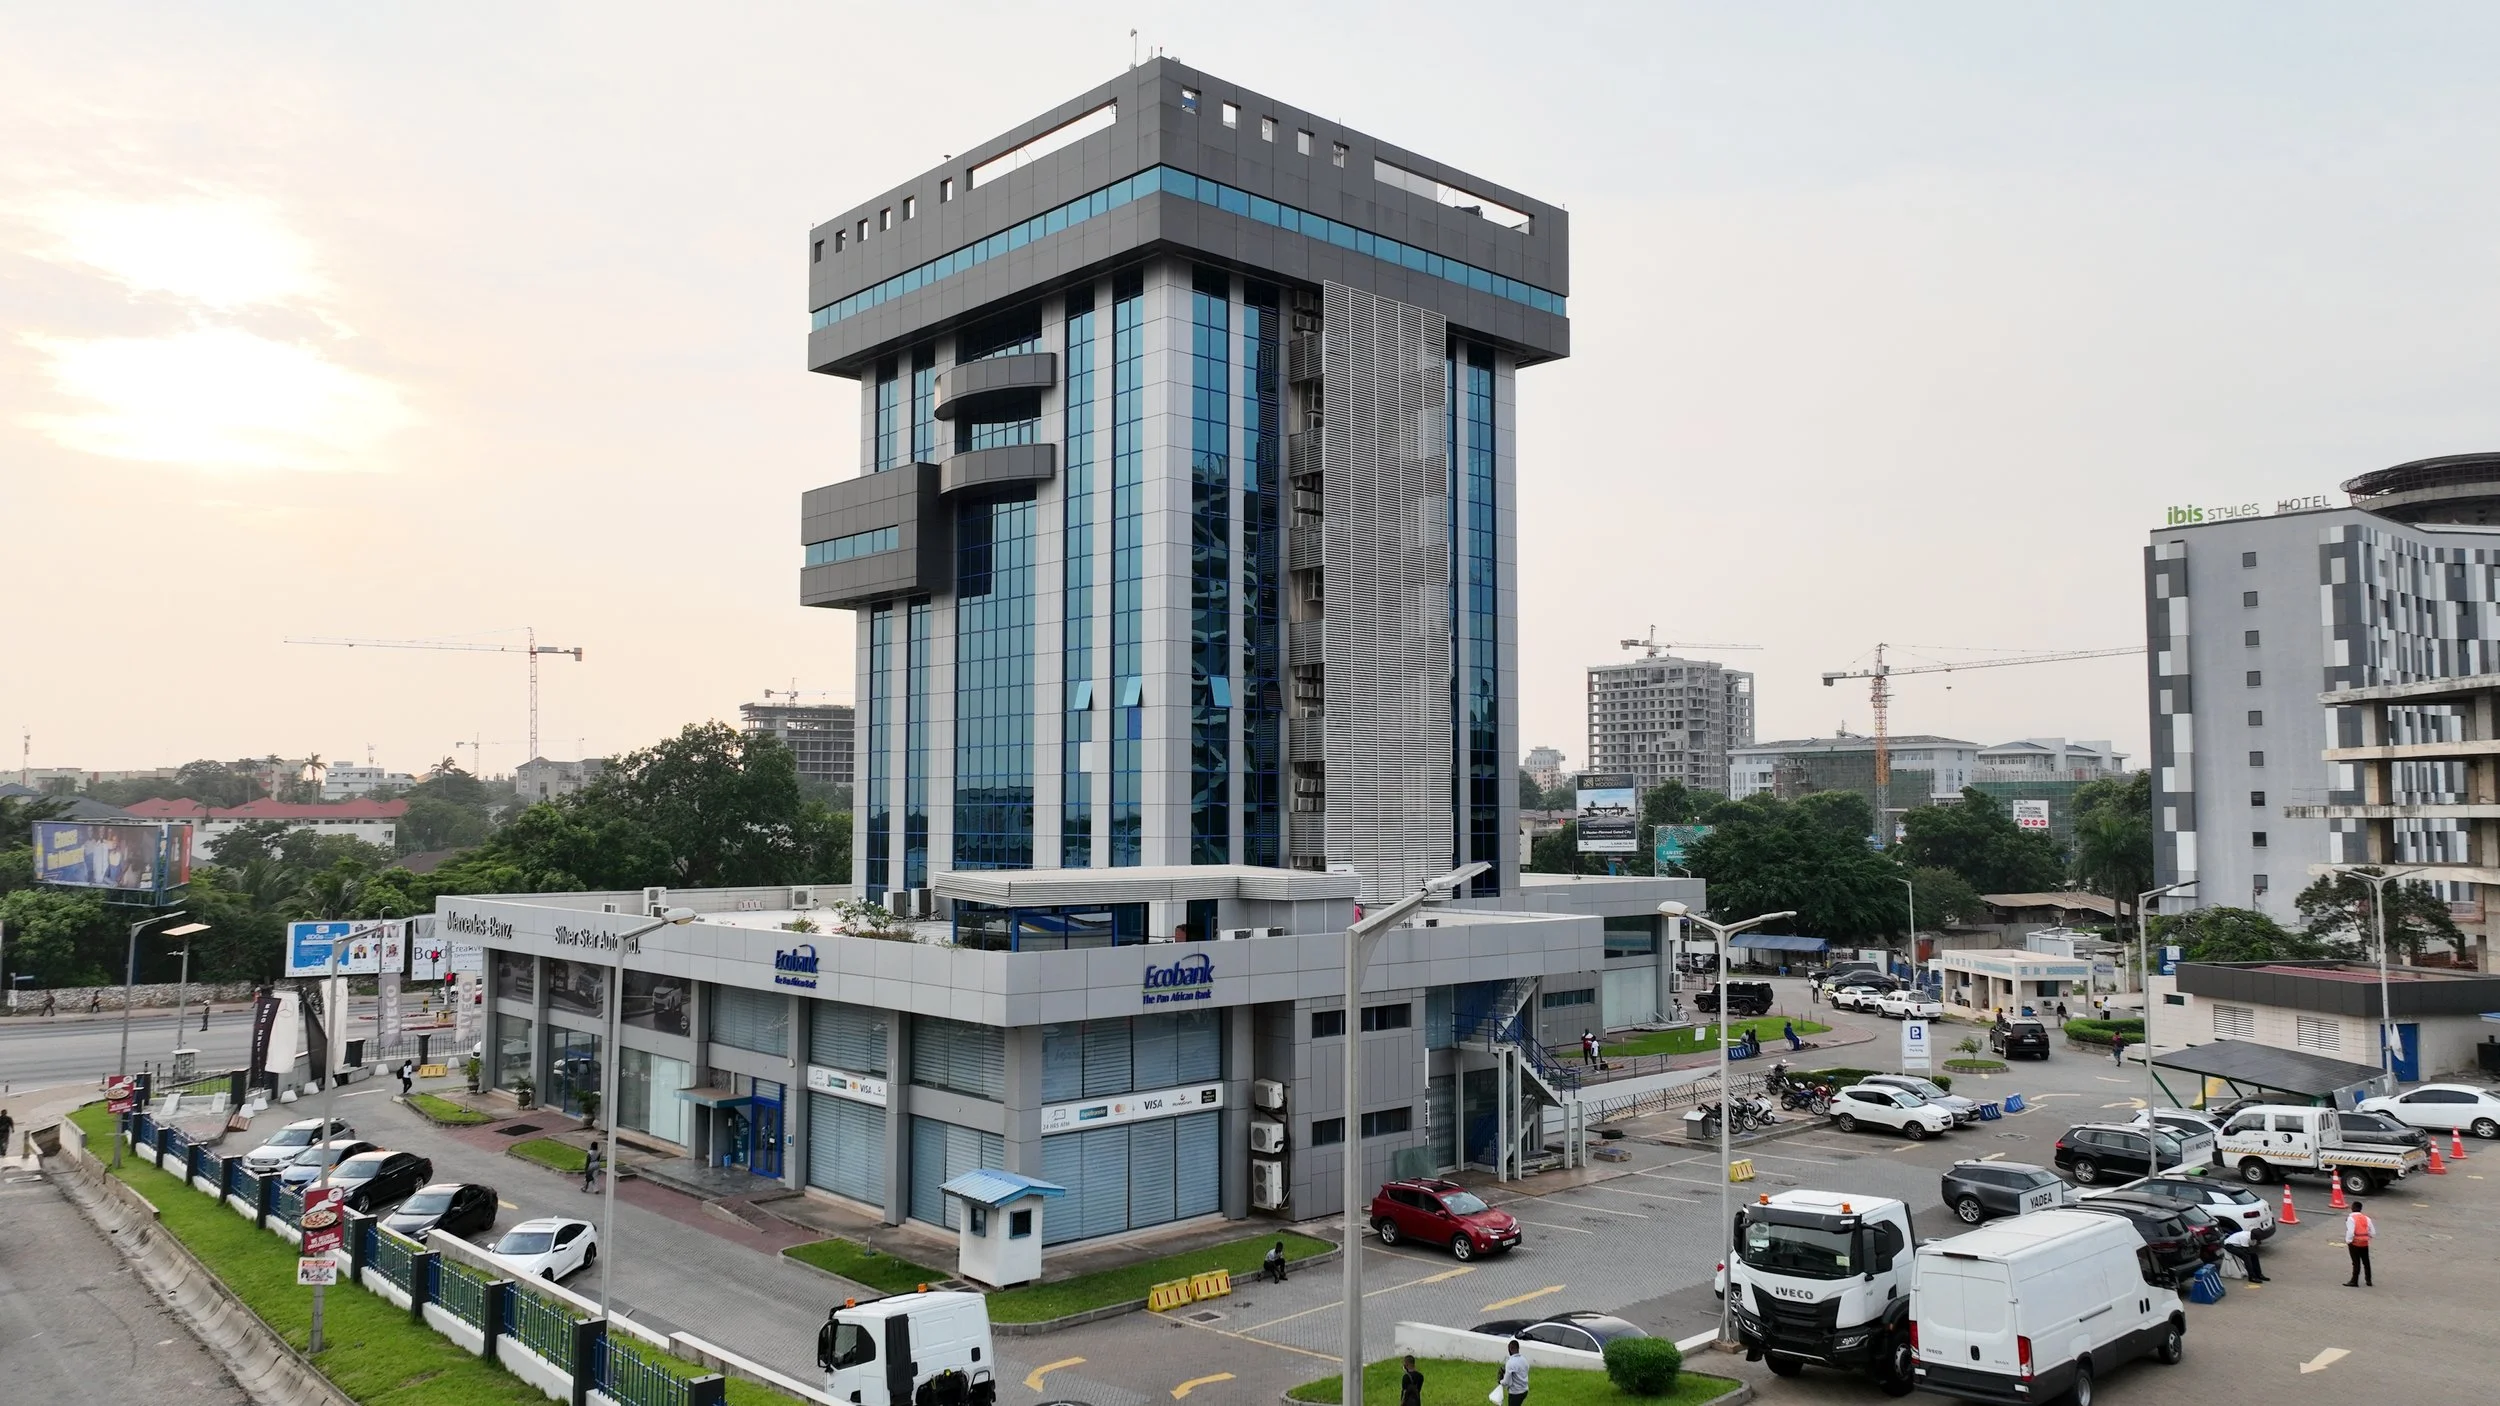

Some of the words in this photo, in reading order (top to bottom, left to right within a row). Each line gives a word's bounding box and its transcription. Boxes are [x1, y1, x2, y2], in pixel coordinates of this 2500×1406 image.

[2167, 504, 2204, 525] ibis
[2208, 503, 2260, 521] STYLES
[2277, 495, 2331, 512] HOTEL
[447, 911, 512, 939] Mercedes-Benz
[555, 926, 579, 945] Silver
[580, 929, 599, 947] Star
[775, 944, 820, 974] Ecobank
[1144, 953, 1215, 989] Ecobank
[460, 981, 474, 1030] IVECO
[1143, 995, 1156, 1005] The
[1157, 994, 1170, 1004] Pan
[1170, 992, 1194, 1002] African
[1195, 989, 1212, 1000] Bank
[386, 985, 398, 1034] IVECO
[860, 1084, 872, 1095] VISA
[1144, 1099, 1163, 1110] VISA
[2030, 1192, 2053, 1209] YADEA
[1775, 1286, 1814, 1300] IVECO
